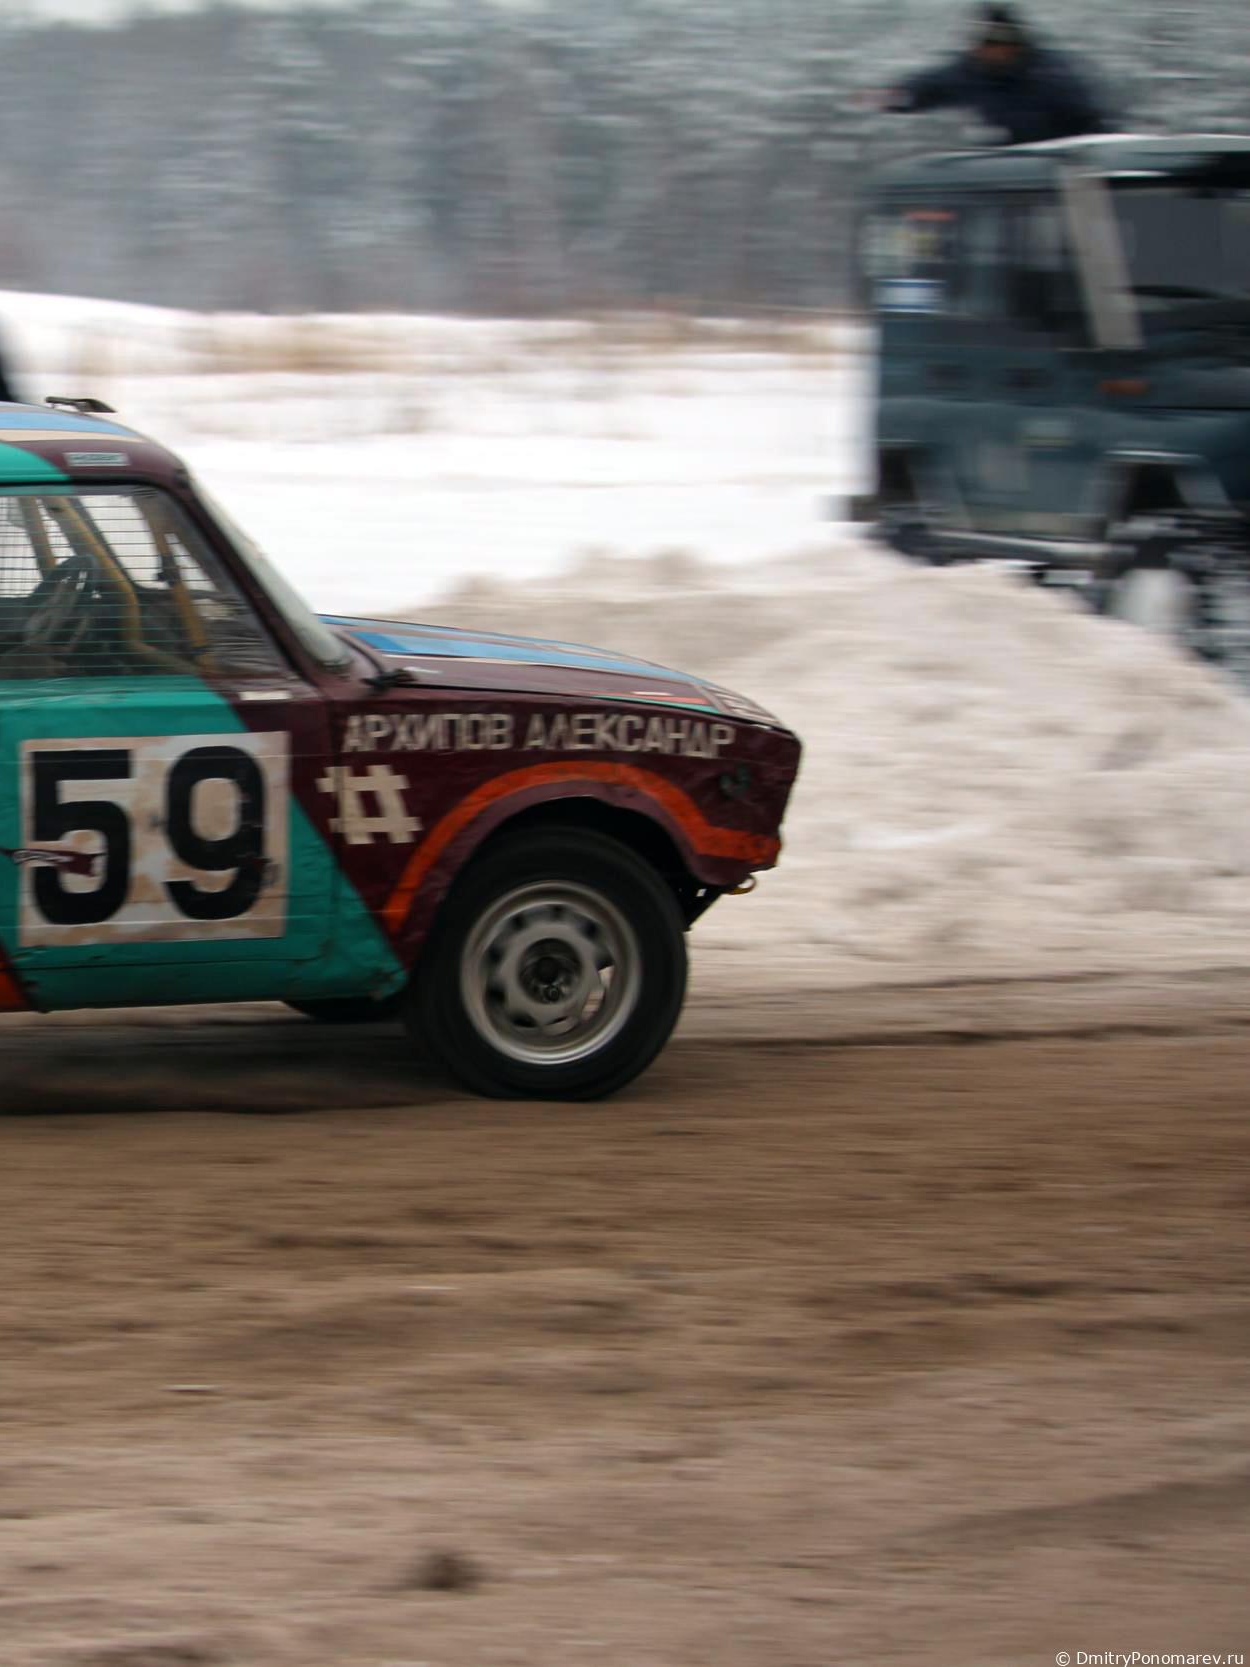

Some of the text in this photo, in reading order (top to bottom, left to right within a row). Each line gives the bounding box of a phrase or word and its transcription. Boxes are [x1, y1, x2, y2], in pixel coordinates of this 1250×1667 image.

[342, 712, 736, 759] АРХИПОВ АЛЕКСАНДР
[30, 744, 265, 926] 59
